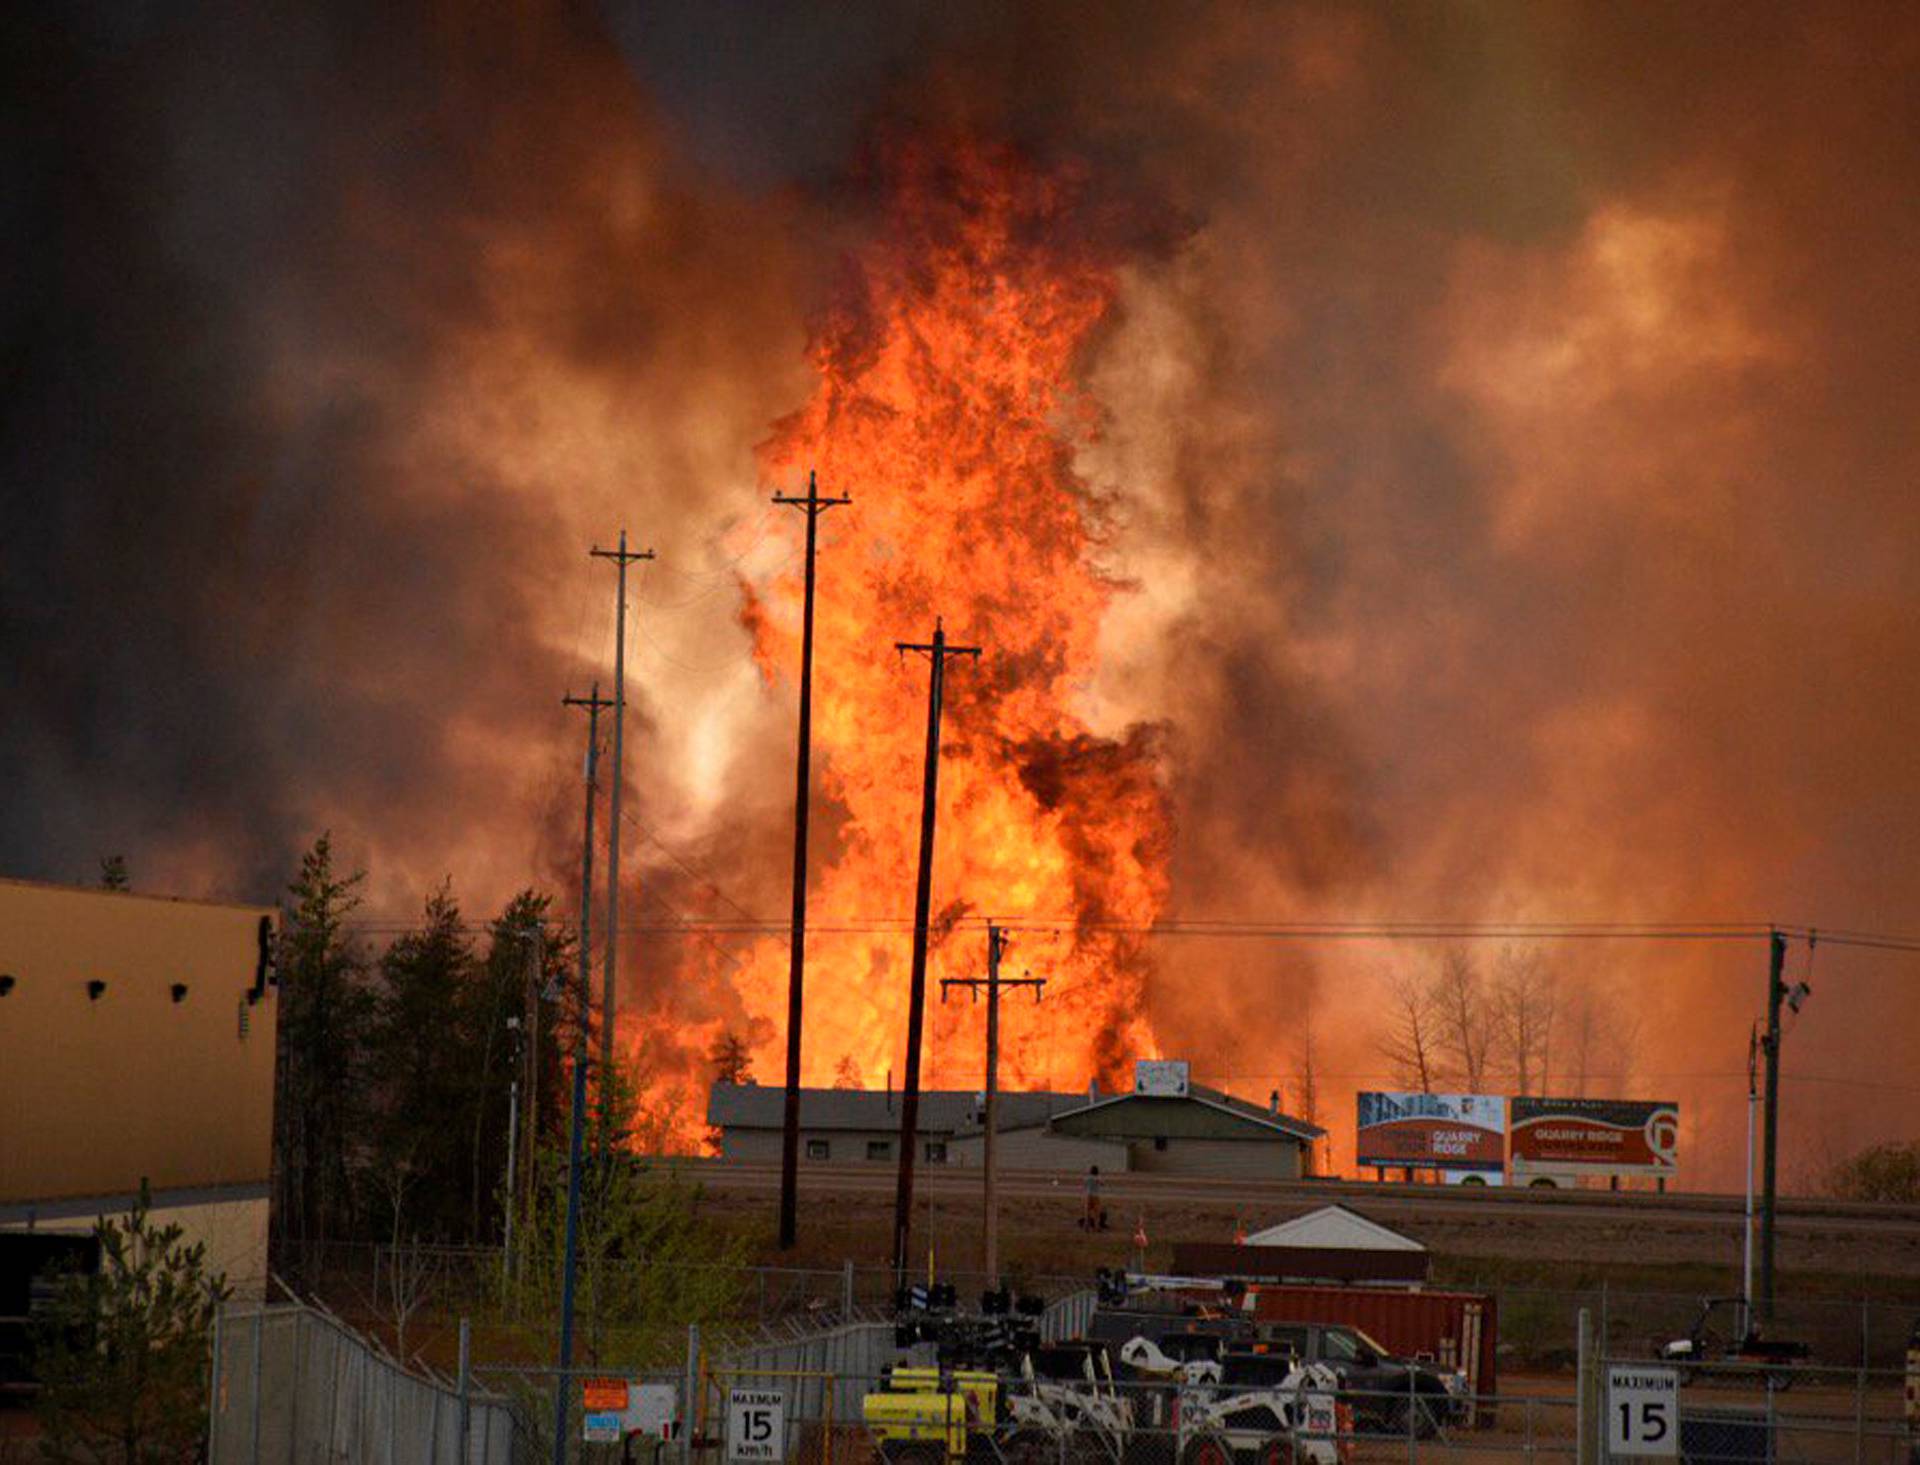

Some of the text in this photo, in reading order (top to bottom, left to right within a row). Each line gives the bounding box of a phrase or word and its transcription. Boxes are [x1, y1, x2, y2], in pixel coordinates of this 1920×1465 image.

[1535, 1128, 1585, 1140] QUARRY
[1613, 1375, 1674, 1391] MAXIMUM
[732, 1394, 781, 1407] MAXIMUM
[743, 1411, 772, 1441] 15
[1619, 1403, 1667, 1442] 15
